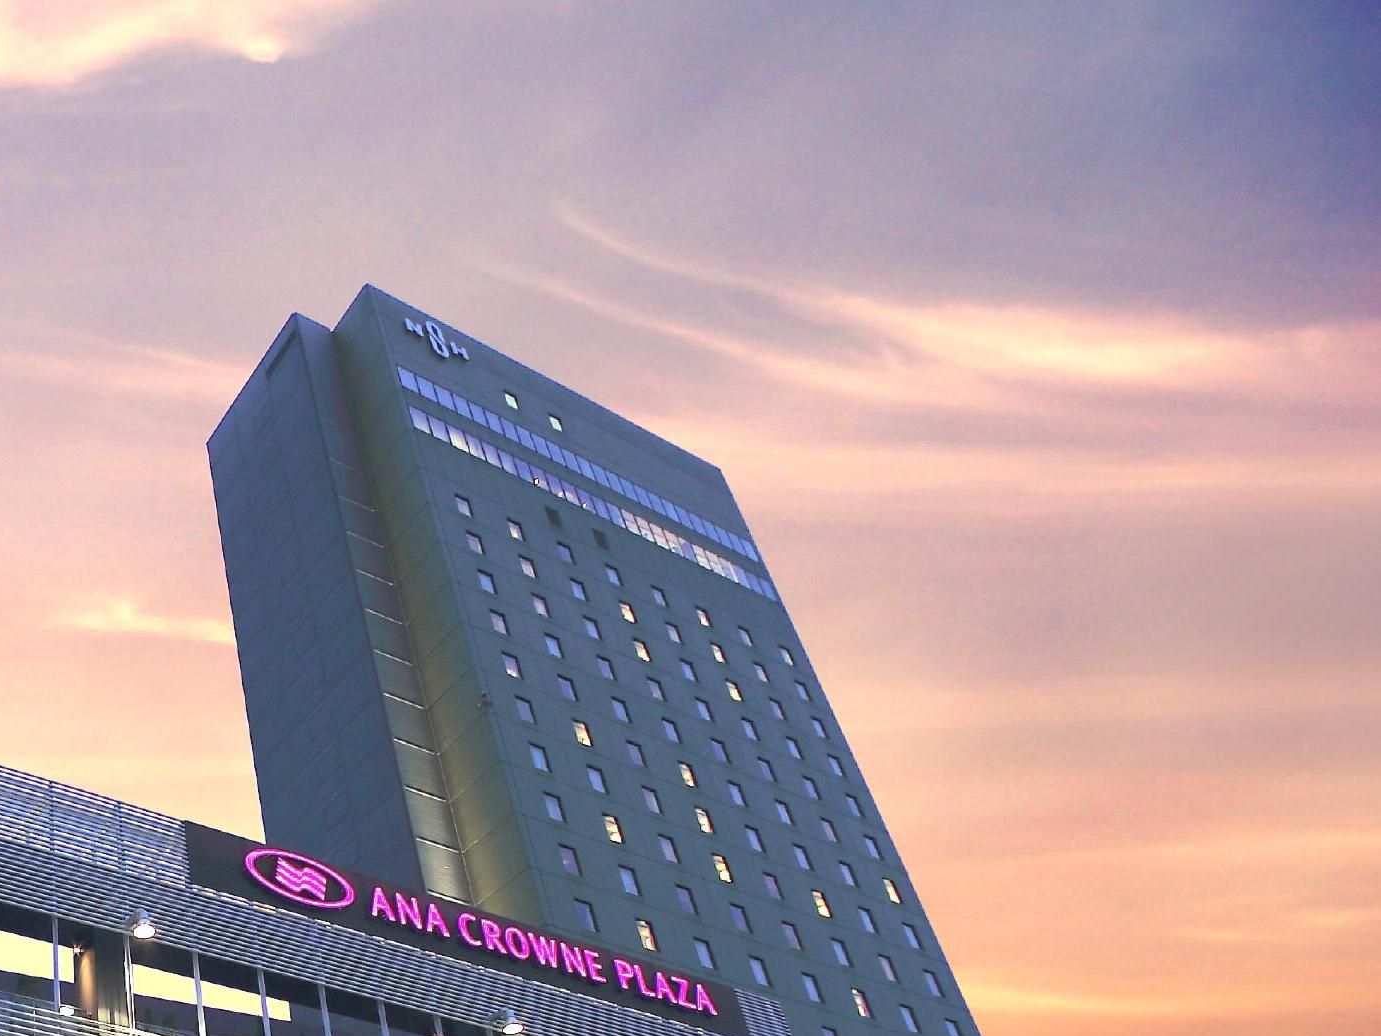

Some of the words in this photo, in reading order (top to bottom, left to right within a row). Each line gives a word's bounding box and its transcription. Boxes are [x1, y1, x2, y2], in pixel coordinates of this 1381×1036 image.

[371, 886, 451, 939] ANA
[457, 912, 607, 984] CROWNE
[613, 957, 719, 1017] PLAZA
